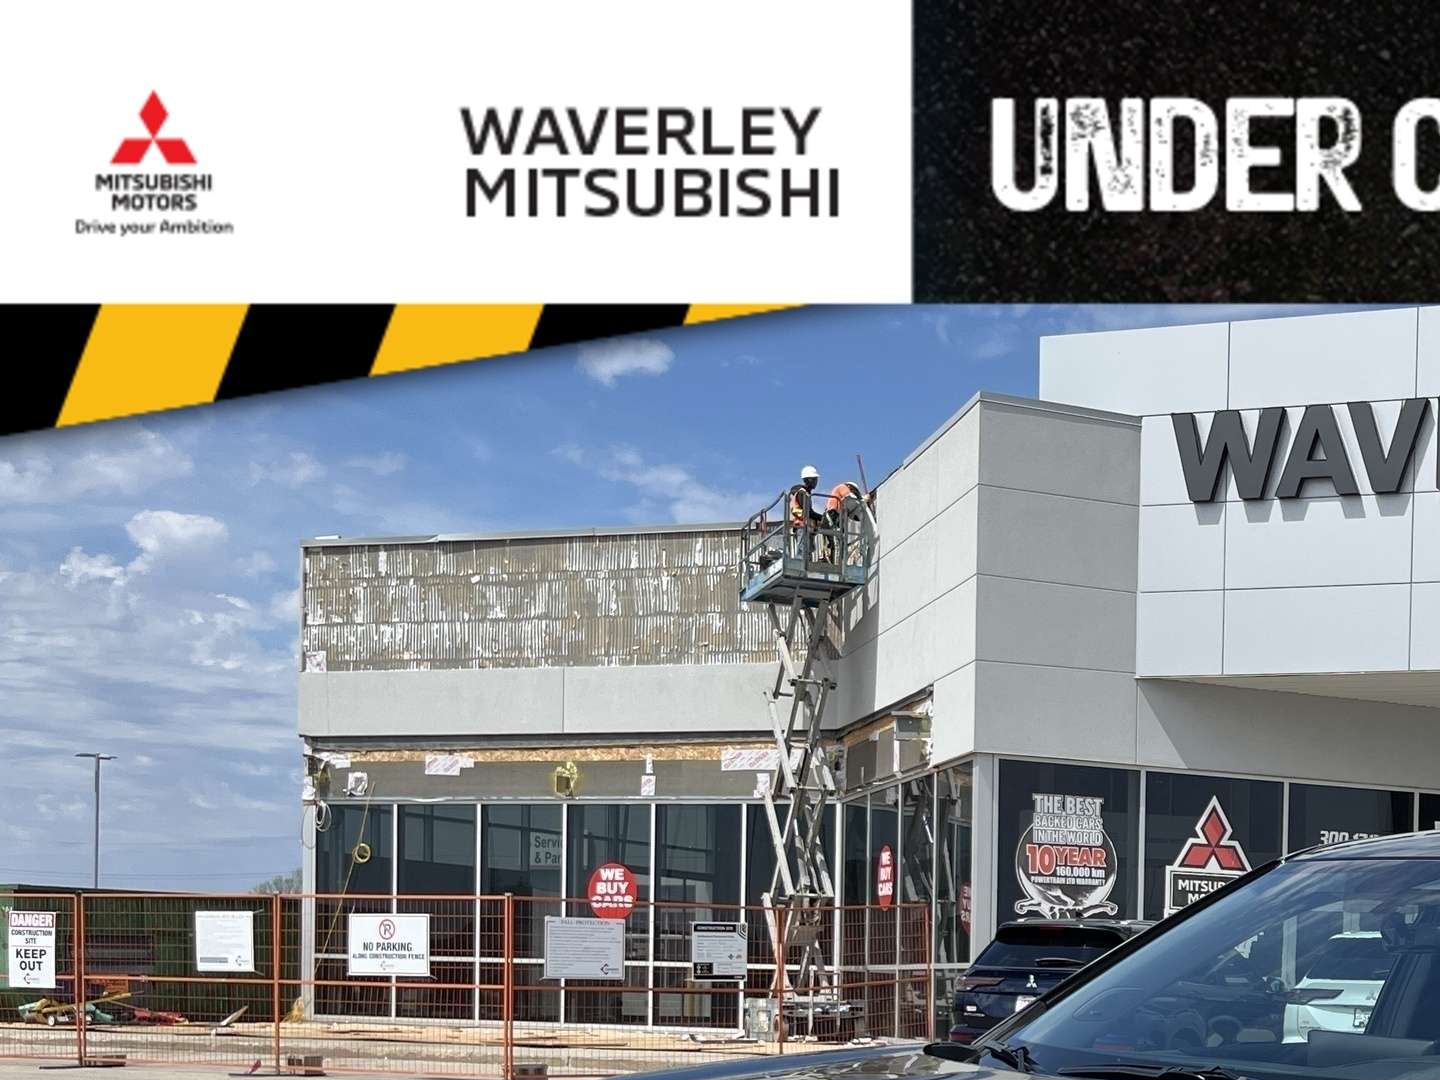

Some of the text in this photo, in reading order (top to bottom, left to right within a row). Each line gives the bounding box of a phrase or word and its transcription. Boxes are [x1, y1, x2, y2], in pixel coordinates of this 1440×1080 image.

[1033, 793, 1104, 817] THE BEST
[1035, 814, 1102, 831] BACKED CARS
[534, 835, 562, 848] Servi
[1035, 829, 1103, 846] IN THE WORLD
[545, 852, 560, 864] Par
[881, 851, 891, 864] WE
[1026, 844, 1107, 875] 10 YEAR
[600, 868, 624, 880] WE
[880, 866, 892, 881] BUY
[1091, 868, 1105, 878] km
[595, 881, 629, 894] BUY
[878, 882, 893, 896] CARS
[1178, 879, 1226, 892] MITSU
[591, 895, 633, 908] CARS
[11, 913, 53, 927] DANGER
[11, 929, 52, 937] CONSTRUCTION
[363, 942, 412, 951] NO PARKING
[16, 948, 47, 959] KEEP
[19, 960, 43, 971] OUT
